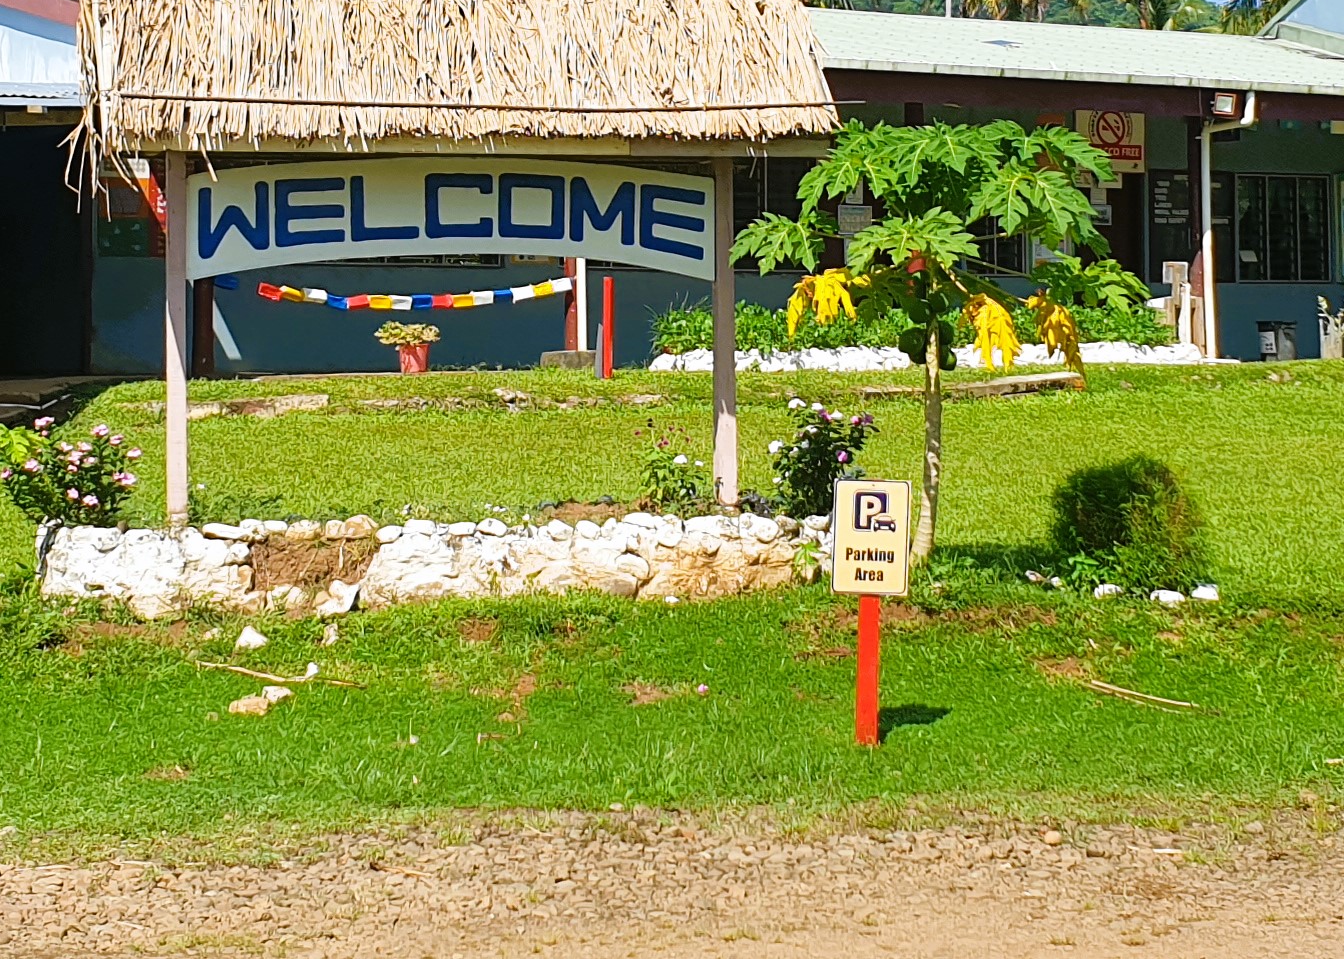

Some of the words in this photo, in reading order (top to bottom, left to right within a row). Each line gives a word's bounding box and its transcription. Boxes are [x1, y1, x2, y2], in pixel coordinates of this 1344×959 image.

[197, 172, 706, 261] WELCOME
[859, 495, 882, 527] P
[845, 547, 895, 563] Parking
[854, 568, 884, 581] Area
